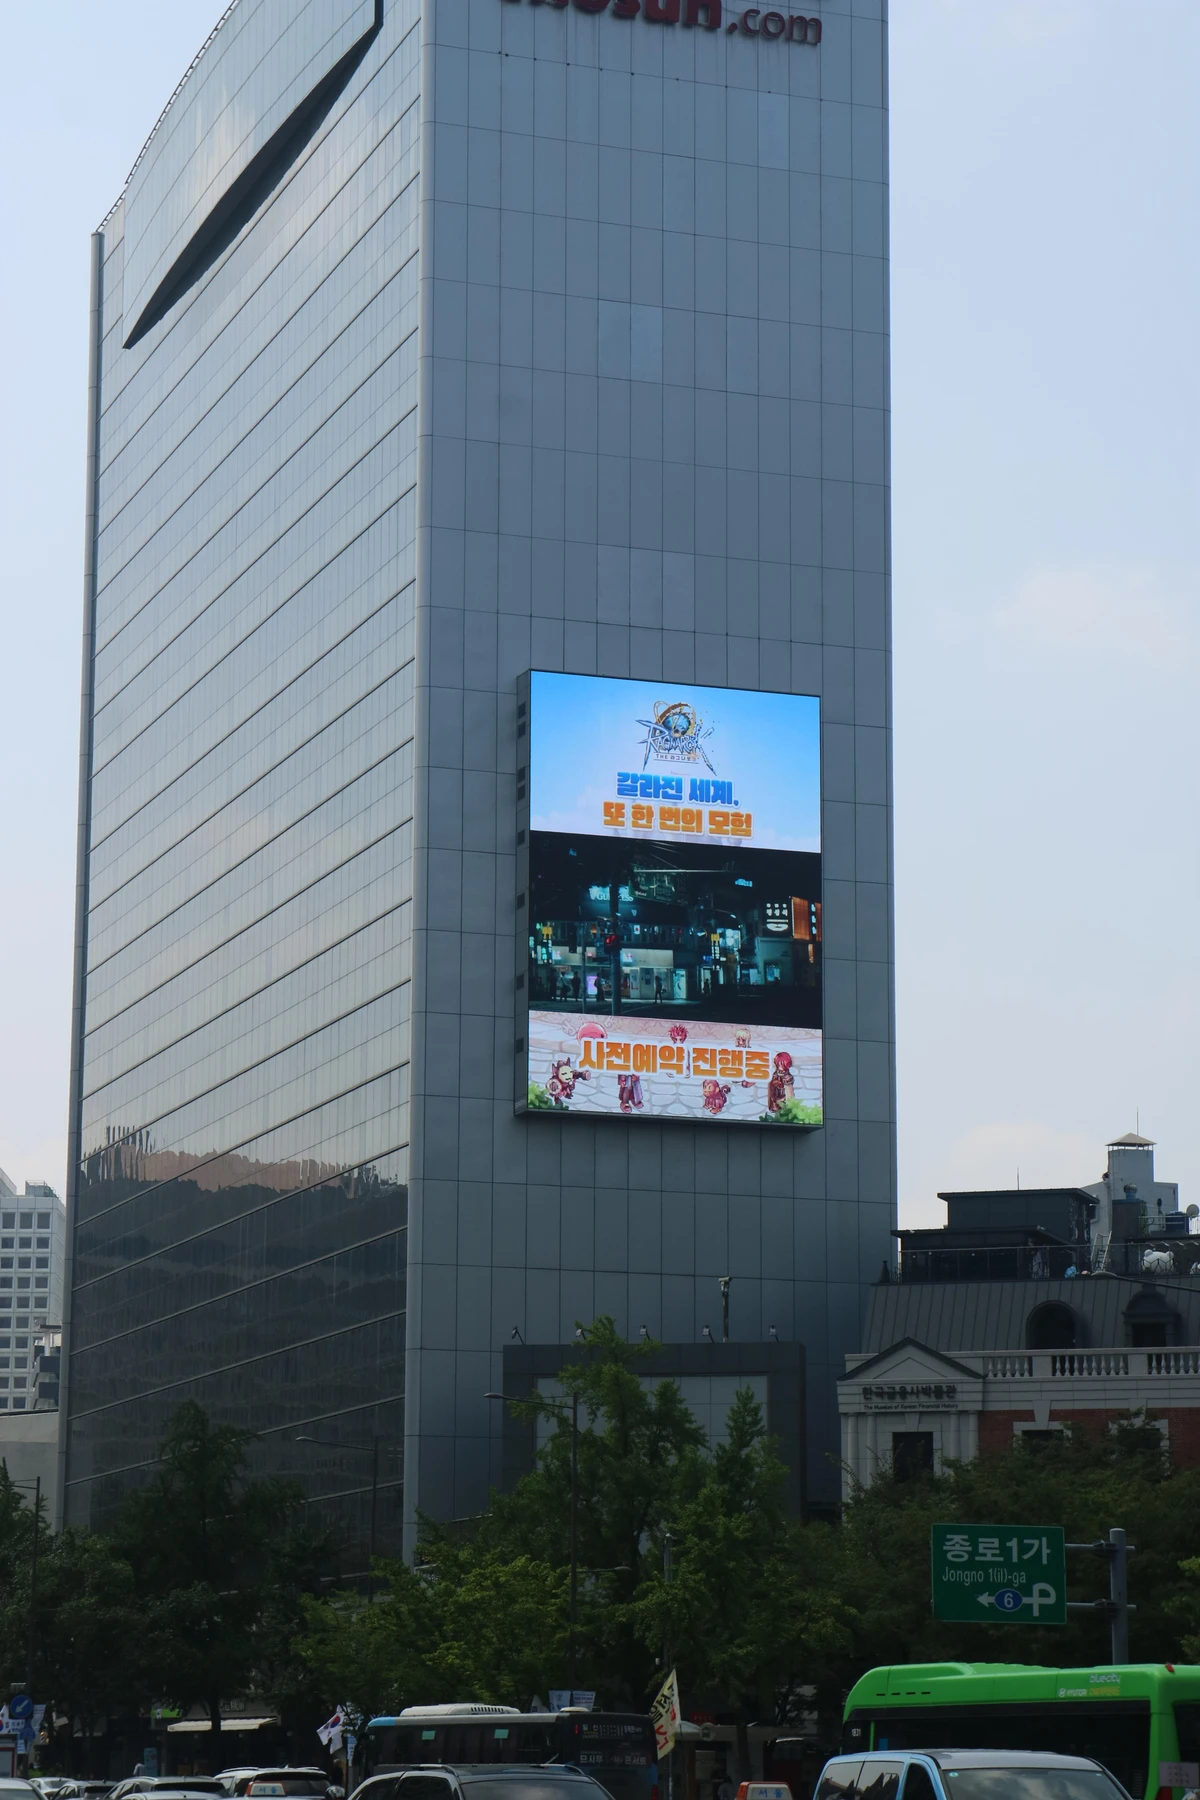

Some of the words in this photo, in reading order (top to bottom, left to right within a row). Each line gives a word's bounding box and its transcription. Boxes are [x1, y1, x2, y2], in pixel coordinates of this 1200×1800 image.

[503, 0, 821, 44] sun.com
[616, 771, 683, 801] 갈라진
[689, 778, 739, 806] 세계,
[603, 801, 625, 827] 또
[631, 804, 653, 829] 한
[659, 806, 702, 833] 번의
[708, 810, 752, 837] 모험
[579, 1040, 687, 1074] 사전예약
[692, 1048, 769, 1079] 진행중
[862, 1385, 957, 1400] 한국금융사박물관
[943, 1534, 1051, 1565] 종로1가
[943, 1567, 984, 1585] Jongno
[988, 1568, 1026, 1586] 1(il)-ga
[1004, 1593, 1014, 1608] 6
[258, 1786, 277, 1794] 서울
[759, 1788, 783, 1798] 서울
